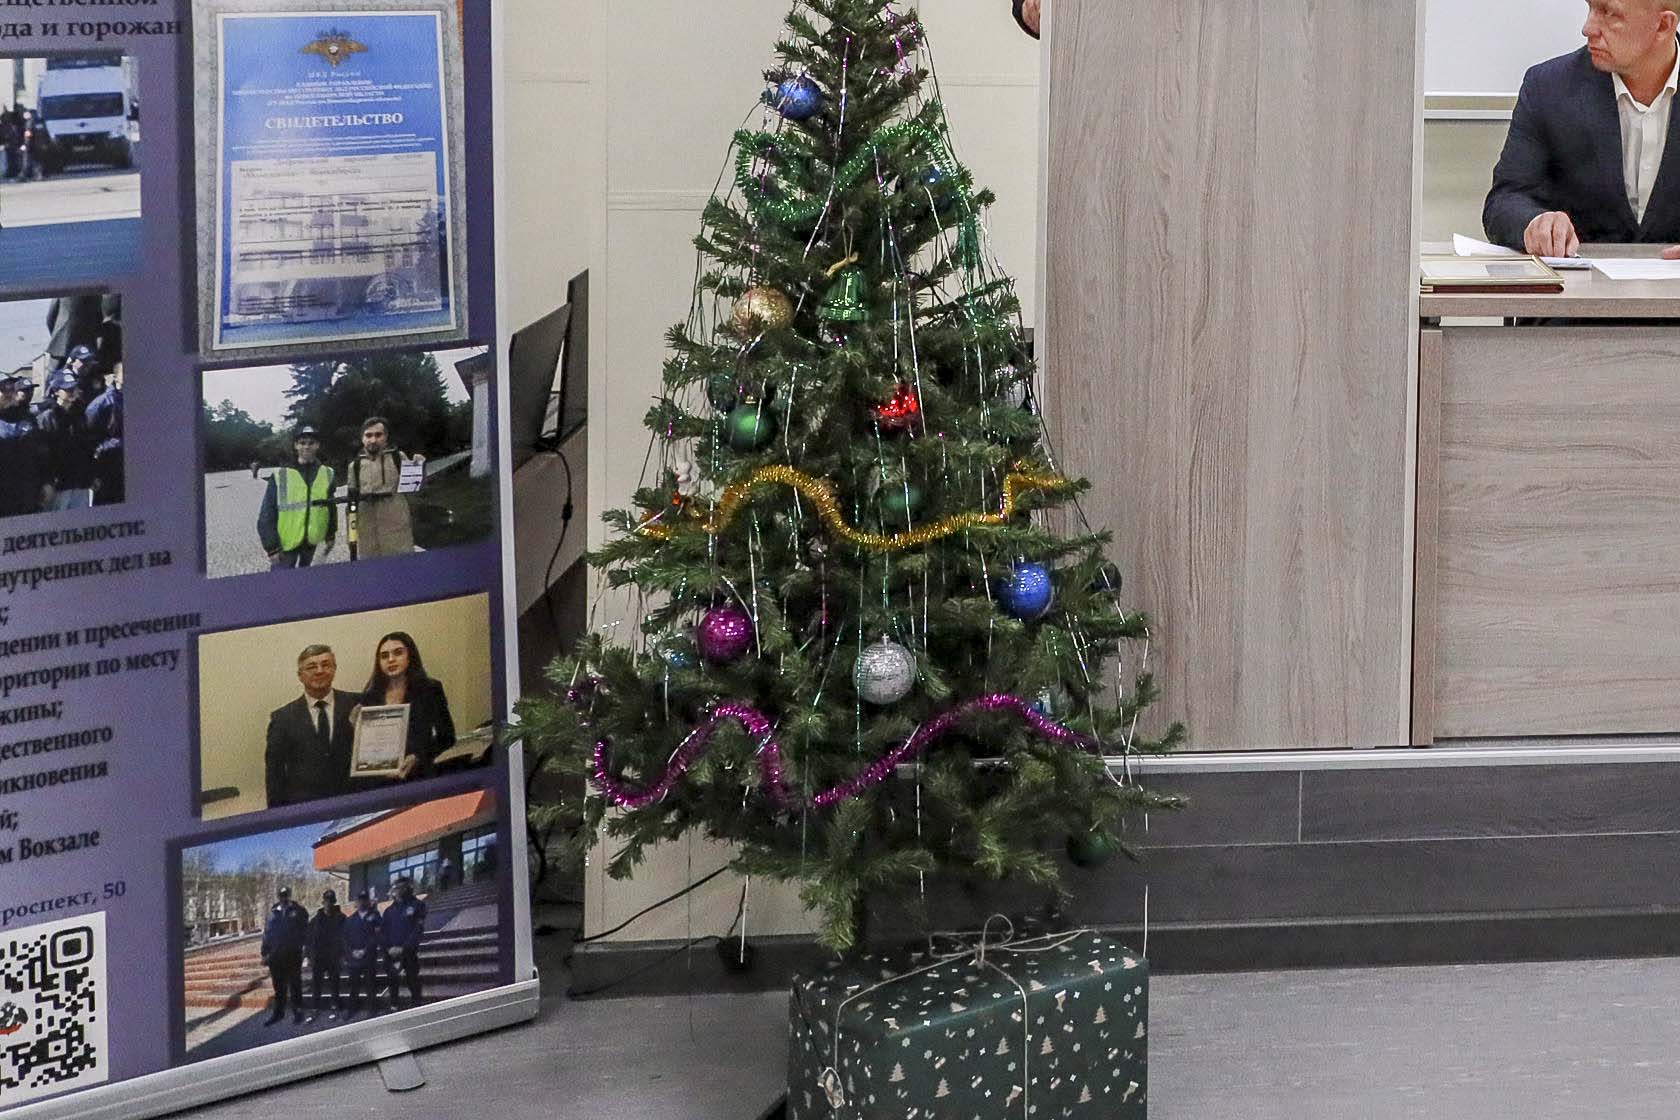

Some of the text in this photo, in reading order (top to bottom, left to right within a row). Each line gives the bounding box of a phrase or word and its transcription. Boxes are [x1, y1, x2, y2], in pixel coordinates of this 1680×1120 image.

[40, 21, 59, 36] и
[68, 20, 182, 41] горожан
[264, 112, 404, 130] СВИДЕТЕЛЬСТВО
[2, 520, 146, 554] деятельности:
[108, 553, 144, 574] дел
[149, 549, 174, 566] на
[66, 630, 80, 646] и
[85, 611, 202, 649] пресечении
[0, 649, 182, 698] ритории по месту
[0, 727, 113, 762] ественного
[19, 830, 100, 861] Вокзале
[1, 880, 126, 926] роспект, 50
